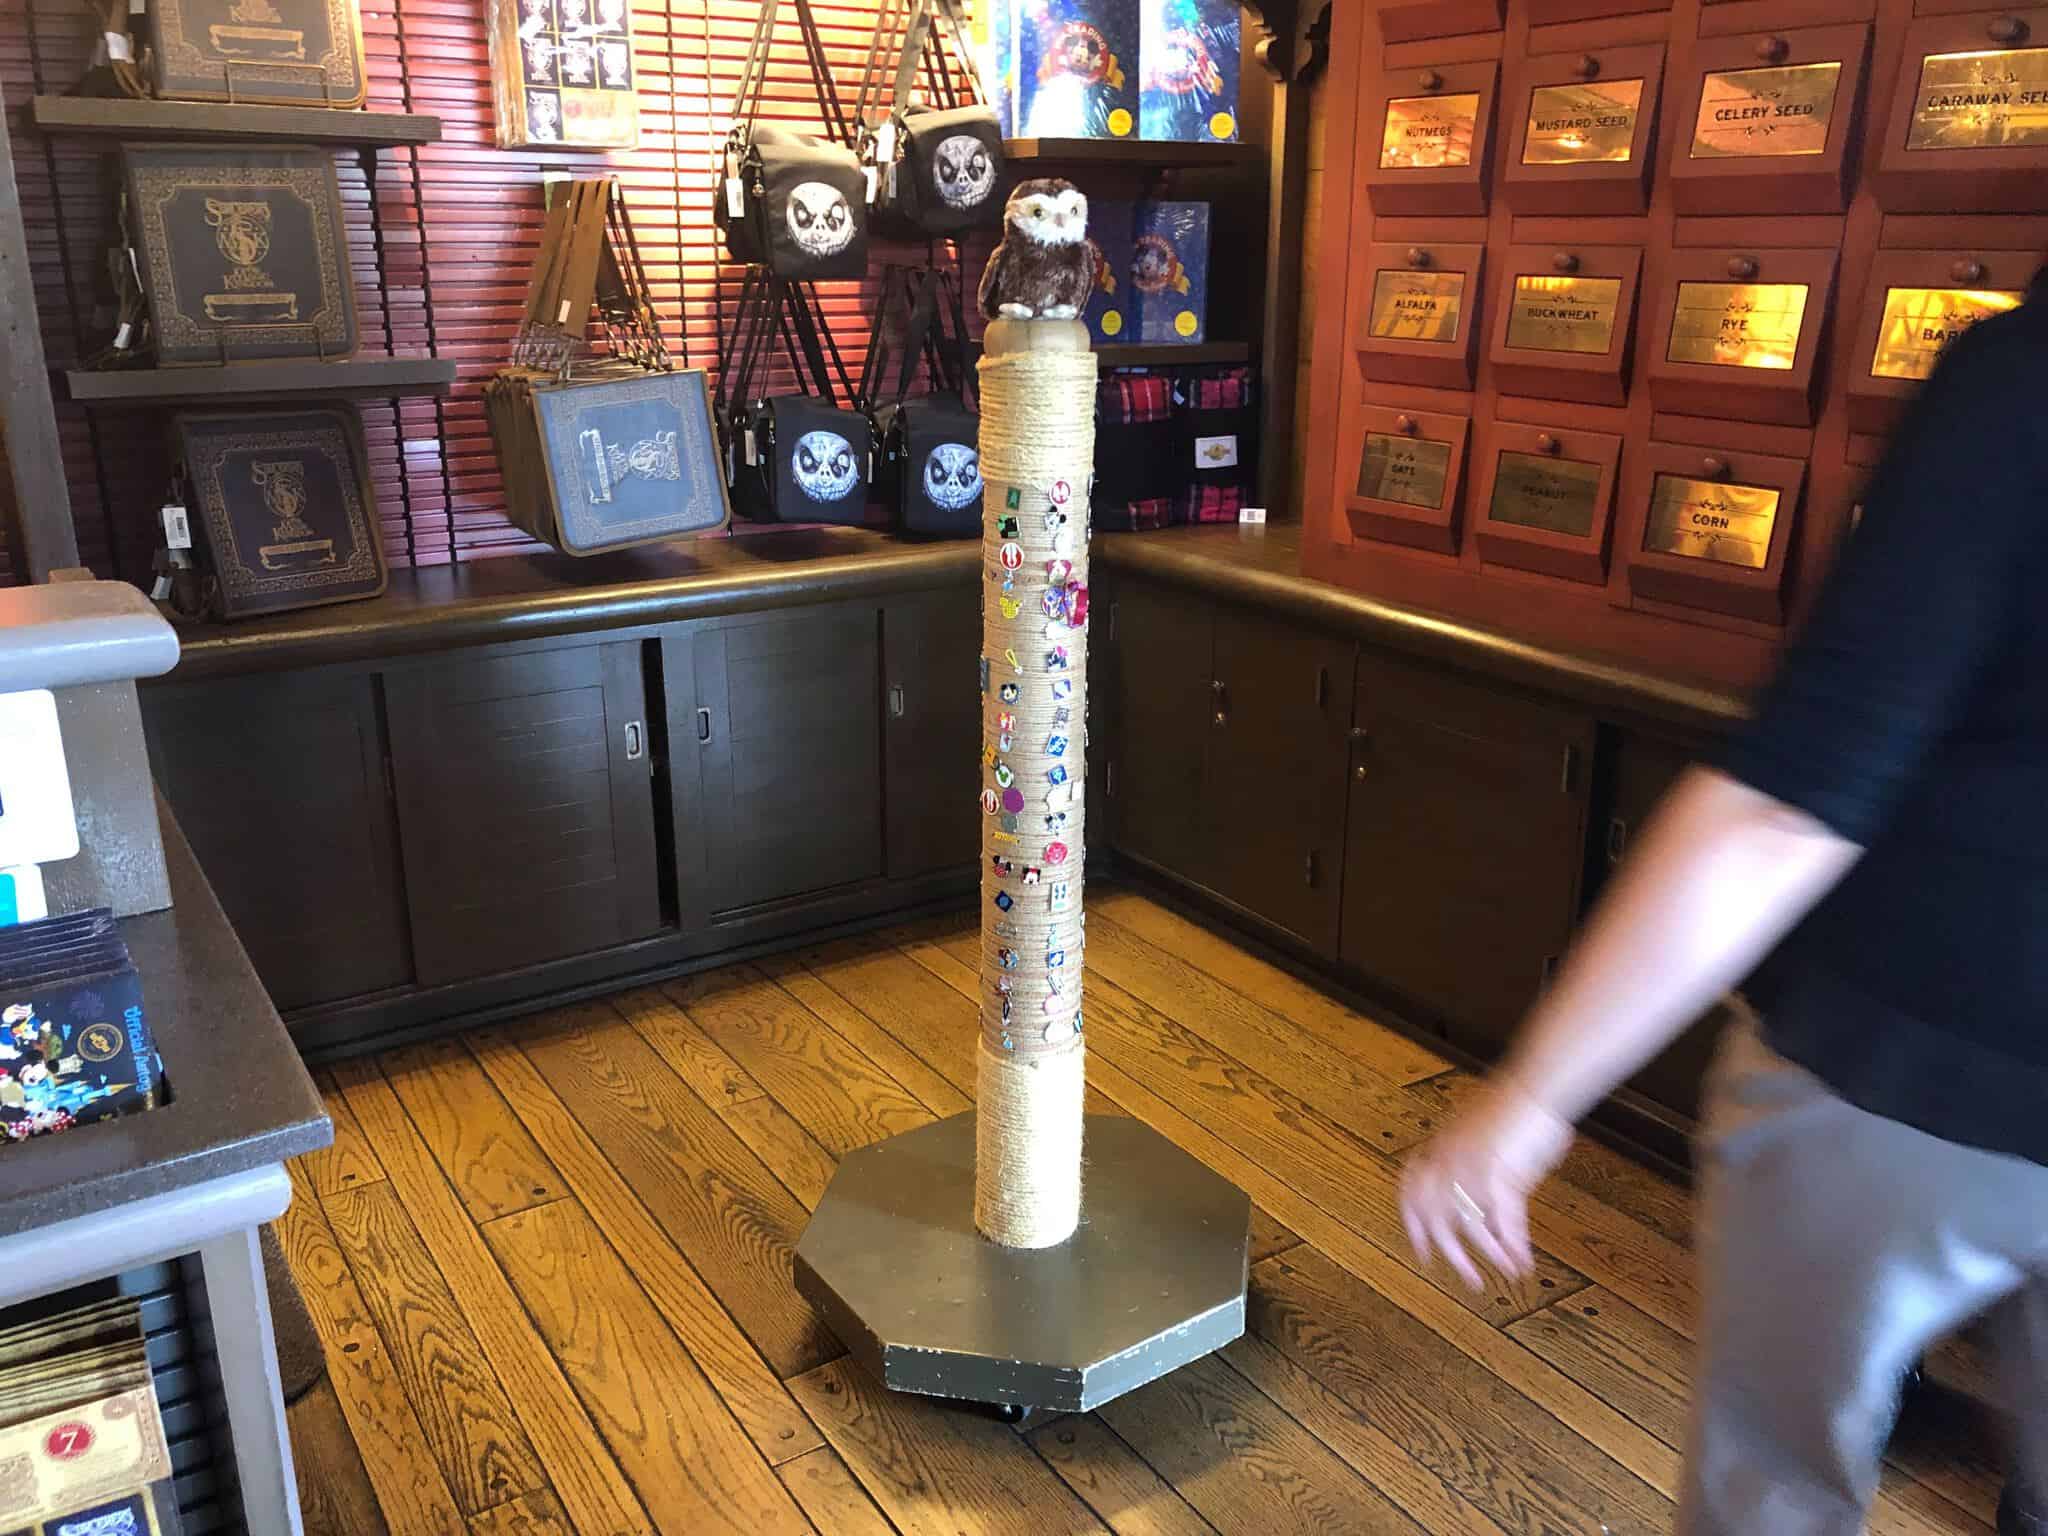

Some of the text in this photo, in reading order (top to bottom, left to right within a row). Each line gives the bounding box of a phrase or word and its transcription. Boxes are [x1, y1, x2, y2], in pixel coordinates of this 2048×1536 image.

[1927, 92, 2012, 108] CARAWAY
[1714, 103, 1814, 122] CELERY SEED
[1535, 115, 1628, 131] MUSTARD SEED
[1405, 126, 1453, 138] NUTMEGS
[1394, 299, 1438, 312] ALFALFA
[1527, 307, 1600, 321] BUCKWHEAT
[1720, 318, 1750, 331] RYE
[1692, 513, 1730, 529] CORN
[59, 1431, 79, 1454] 7
